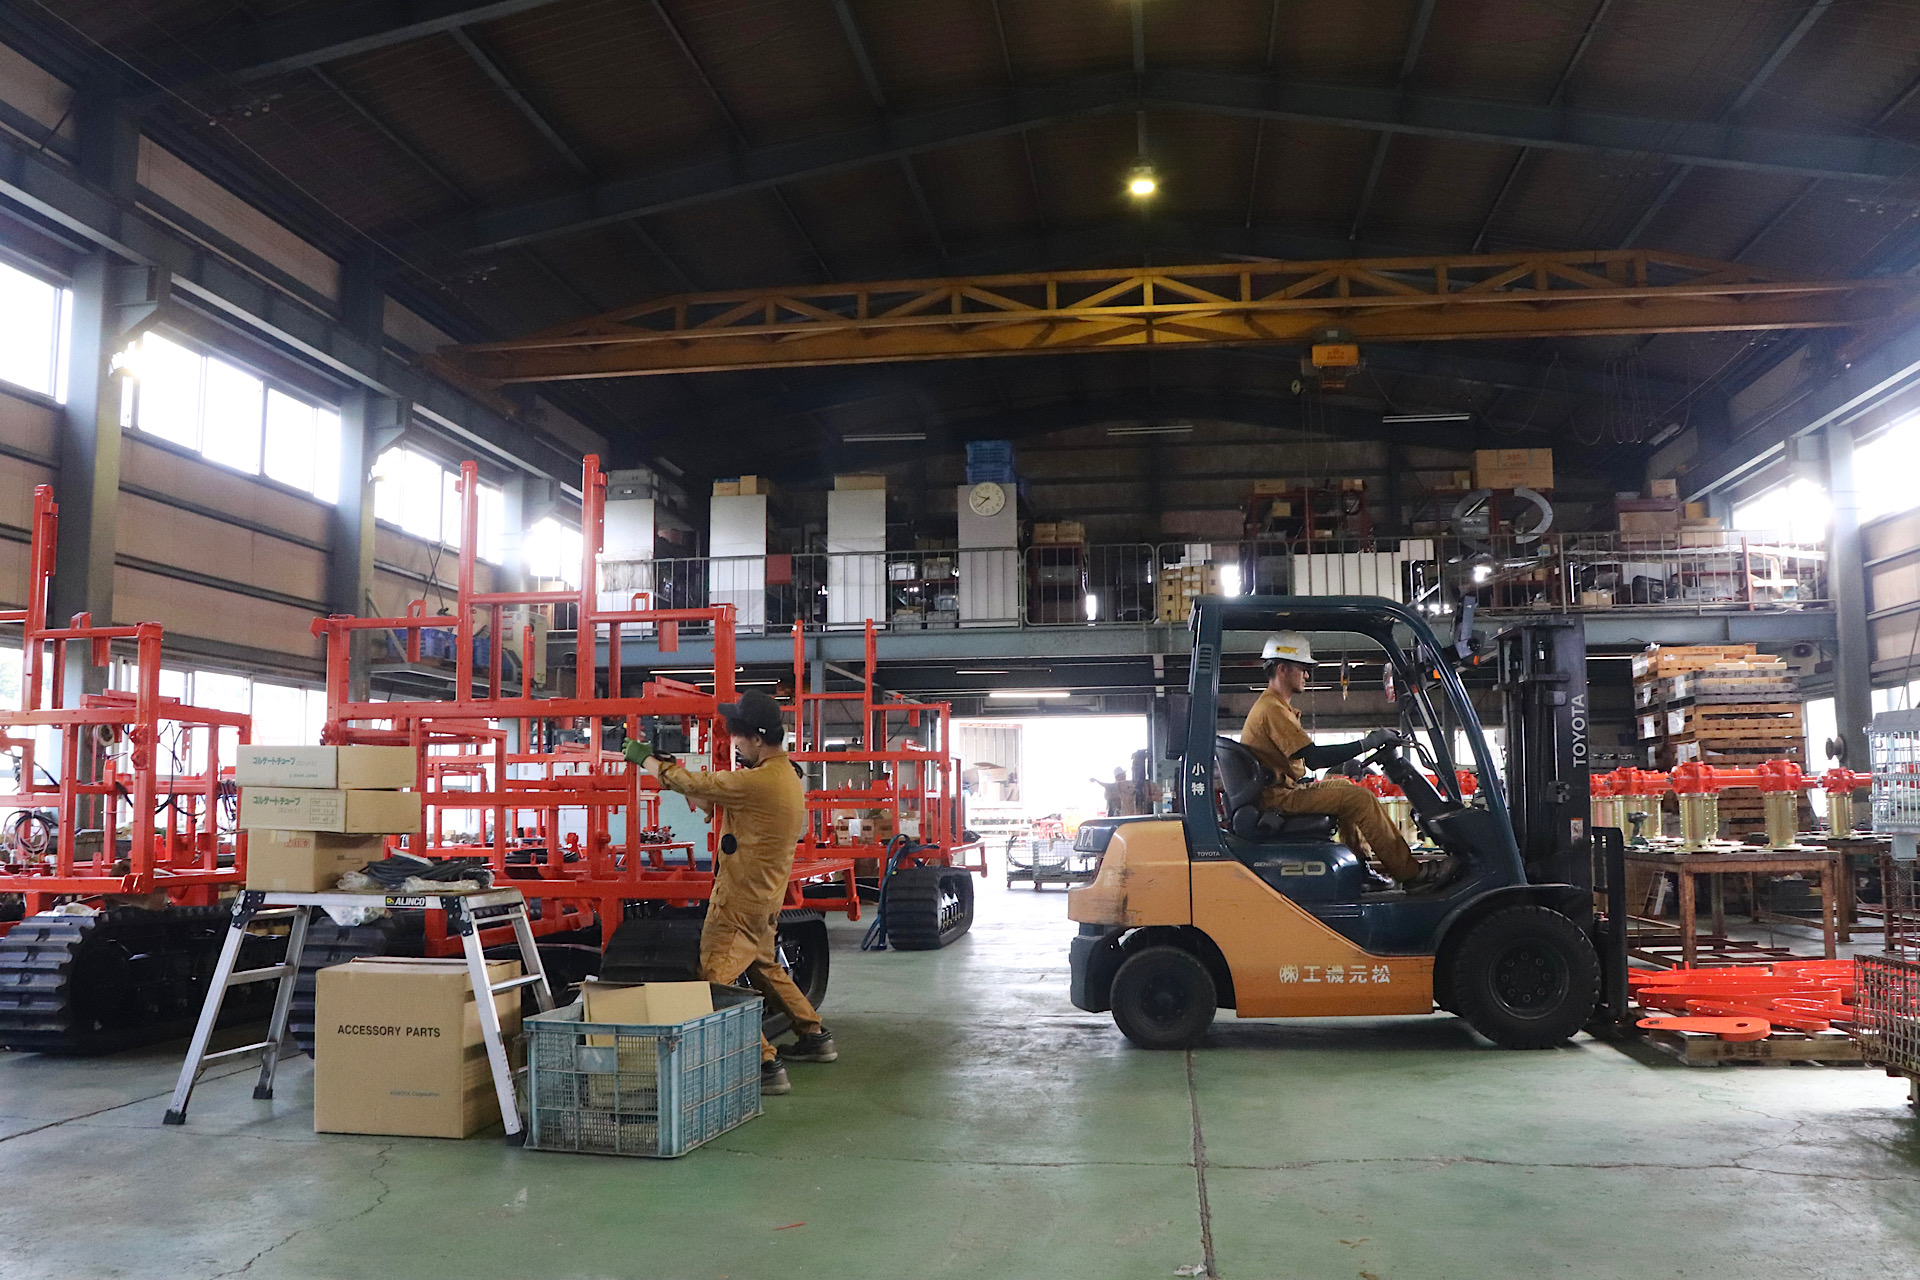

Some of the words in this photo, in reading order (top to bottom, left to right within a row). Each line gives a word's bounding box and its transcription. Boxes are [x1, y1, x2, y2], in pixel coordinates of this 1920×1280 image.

[1571, 694, 1587, 768] TOYOTA
[1191, 762, 1205, 796] 小特
[1281, 861, 1326, 876] 20
[395, 898, 425, 906] ALINCO
[337, 1024, 401, 1036] ACCESSORY
[406, 1027, 441, 1038] PARTS
